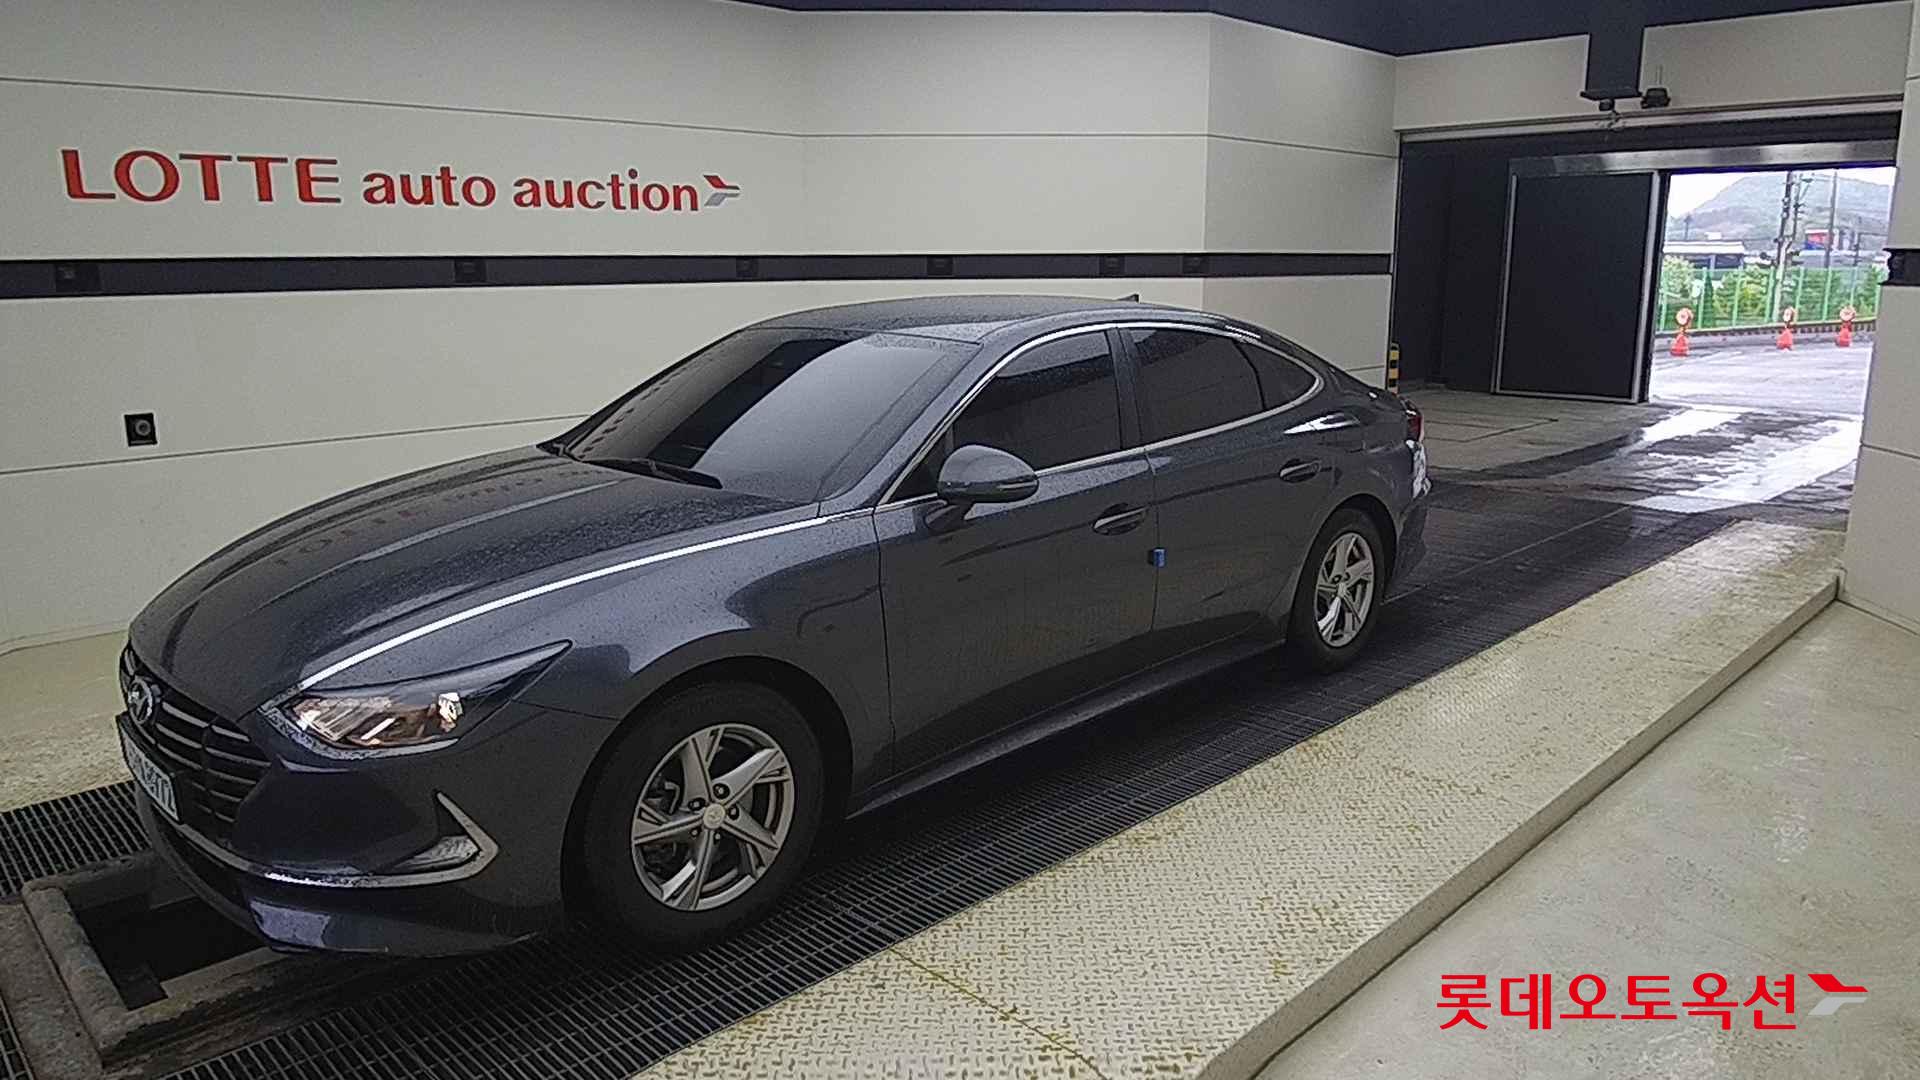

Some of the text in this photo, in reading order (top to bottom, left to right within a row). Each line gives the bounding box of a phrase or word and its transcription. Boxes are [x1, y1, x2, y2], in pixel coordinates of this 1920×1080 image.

[61, 148, 699, 212] LOTTE auto auction
